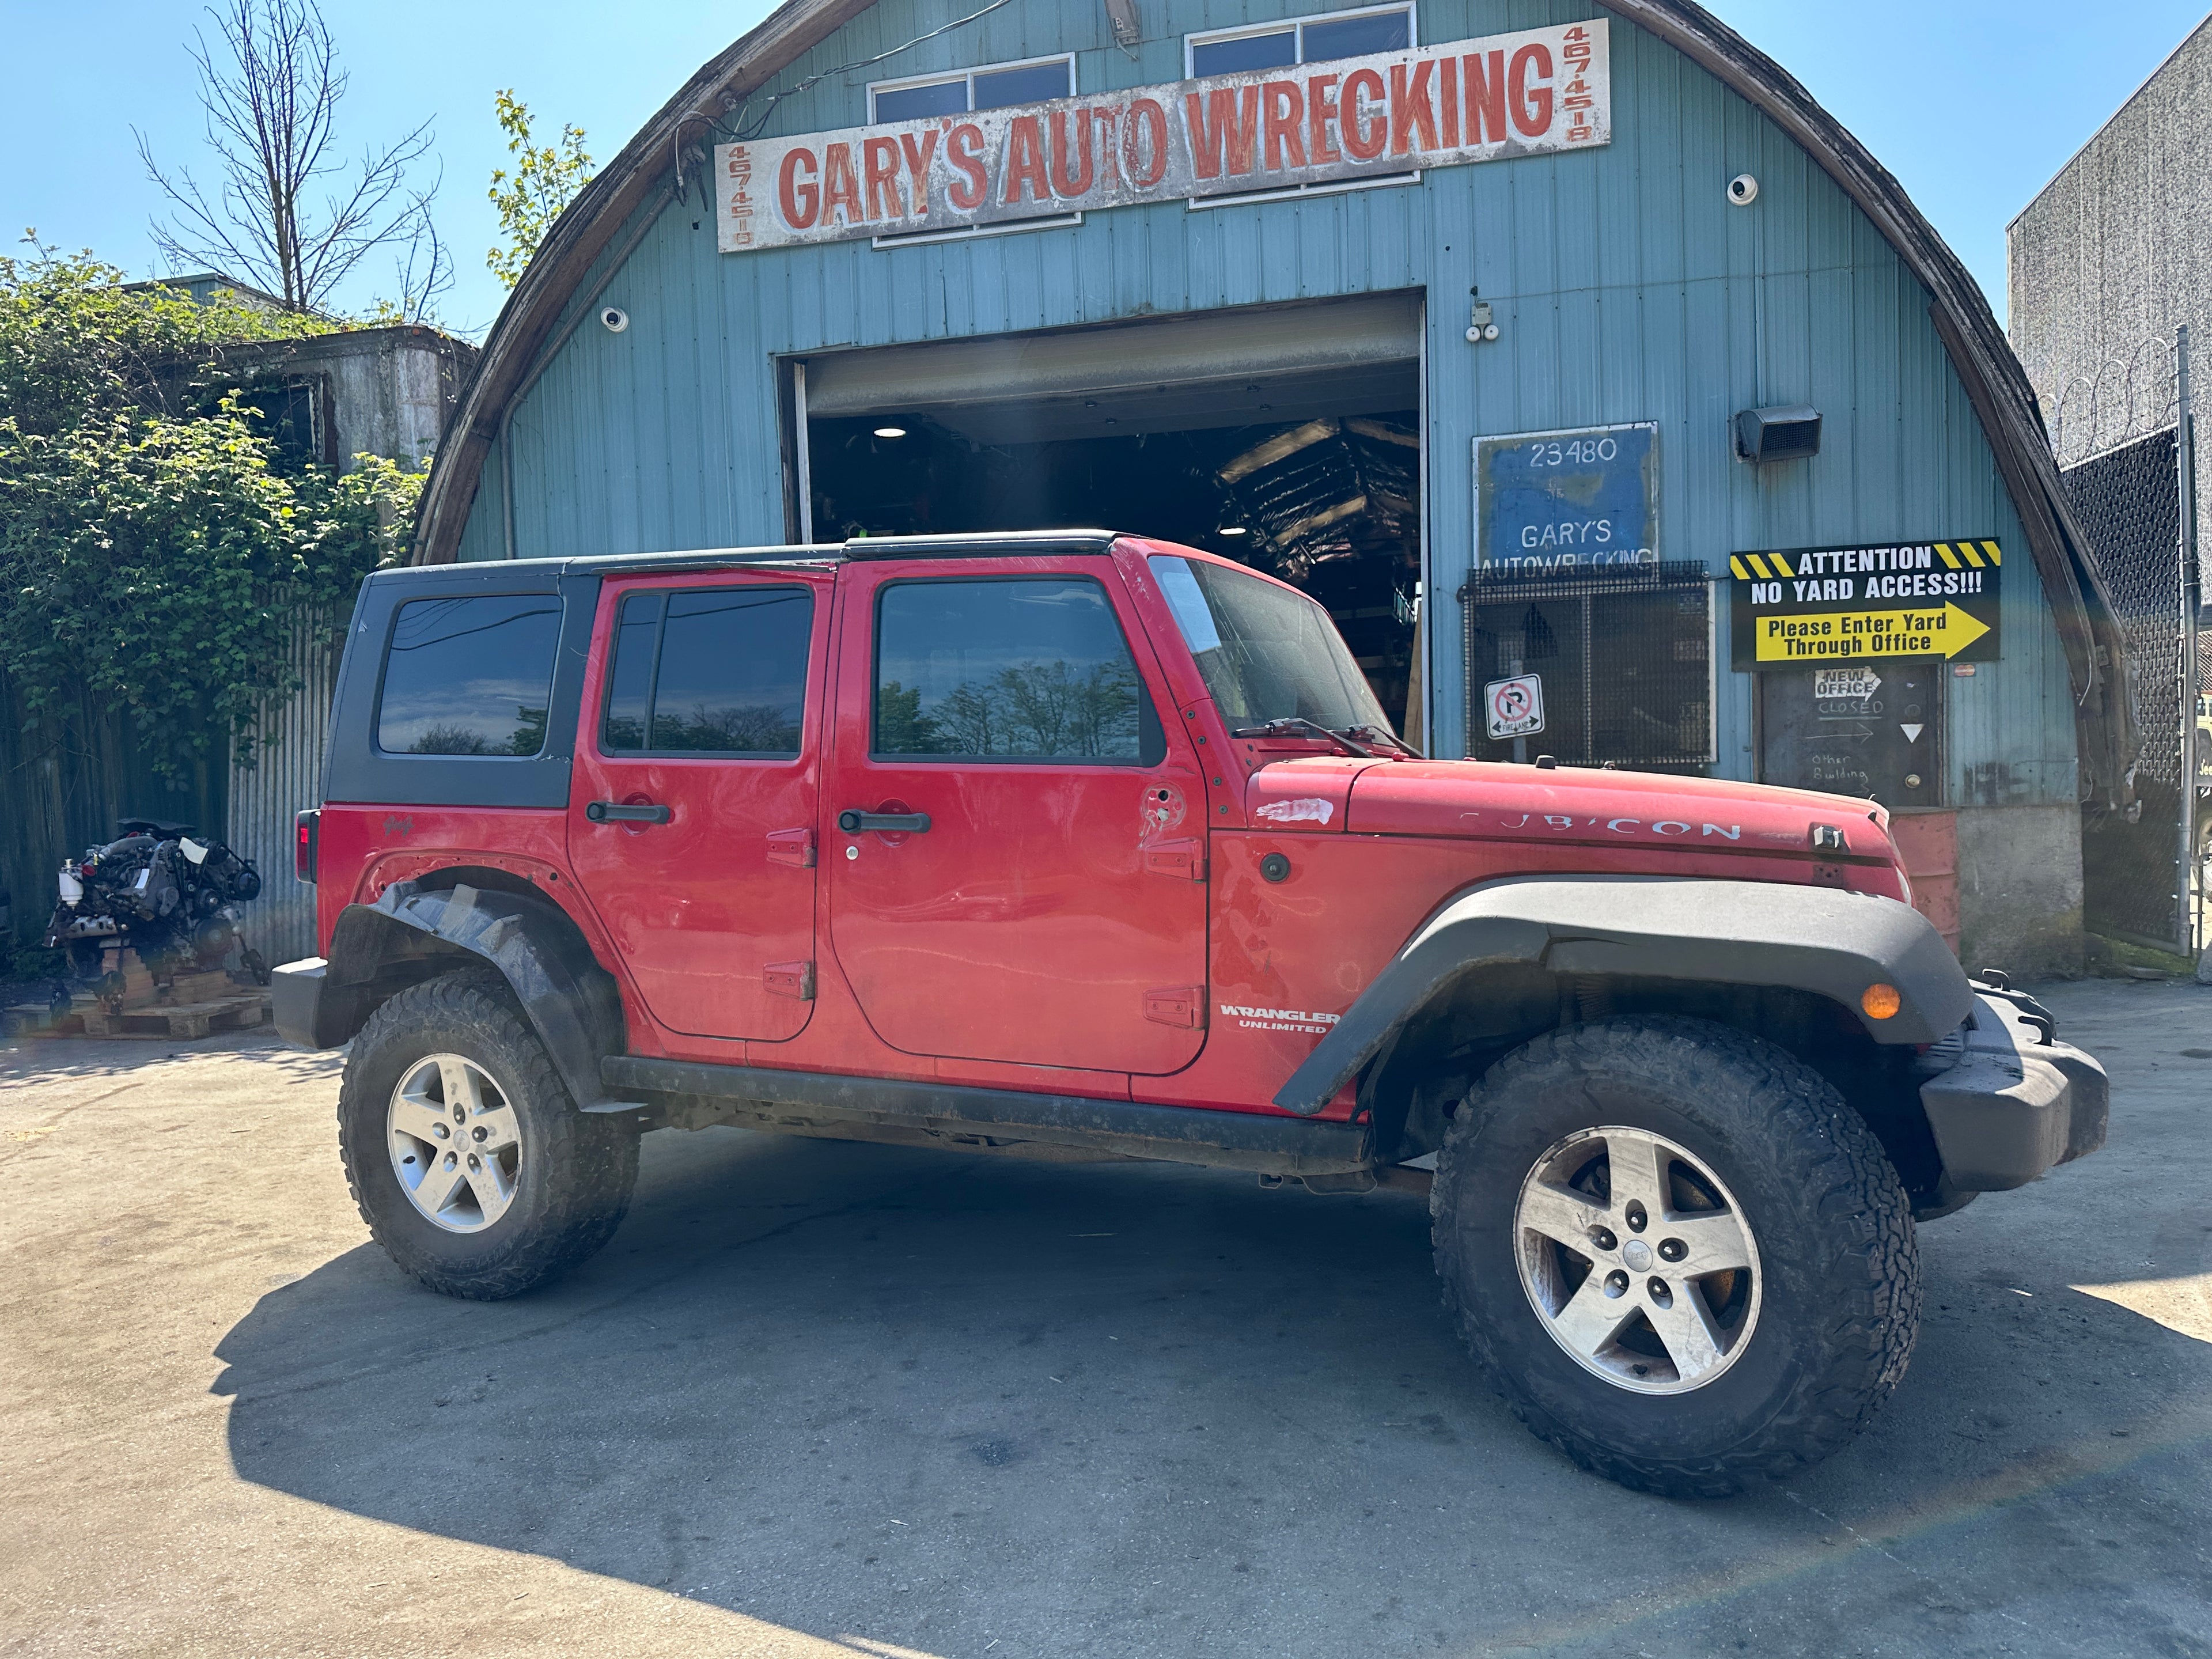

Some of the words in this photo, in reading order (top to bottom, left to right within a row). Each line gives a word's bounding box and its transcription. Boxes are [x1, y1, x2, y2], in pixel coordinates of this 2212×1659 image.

[778, 118, 987, 230] GARY'S
[1005, 98, 1168, 205] AUTO
[1184, 43, 1554, 180] WRECKING
[1530, 438, 1617, 467] 23480
[1521, 519, 1612, 548] GARY'S
[1798, 546, 1931, 575] ATTENTION
[1751, 582, 1782, 604] NO
[1793, 578, 1853, 602] YARD
[1865, 571, 1982, 599] ACCESS!!!
[1768, 619, 1831, 638] Please
[1841, 616, 1893, 634] Enter
[1903, 612, 1946, 631] Yard
[1785, 634, 1862, 656] Through
[1872, 634, 1931, 652] Office
[1824, 670, 1864, 682] NEW
[1817, 682, 1874, 695] OFFICE
[1819, 701, 1883, 714] CLOSED
[1503, 724, 1514, 732] FIRE
[1220, 1005, 1341, 1025] WRANGLER
[1239, 1020, 1327, 1034] UNLIMITED
